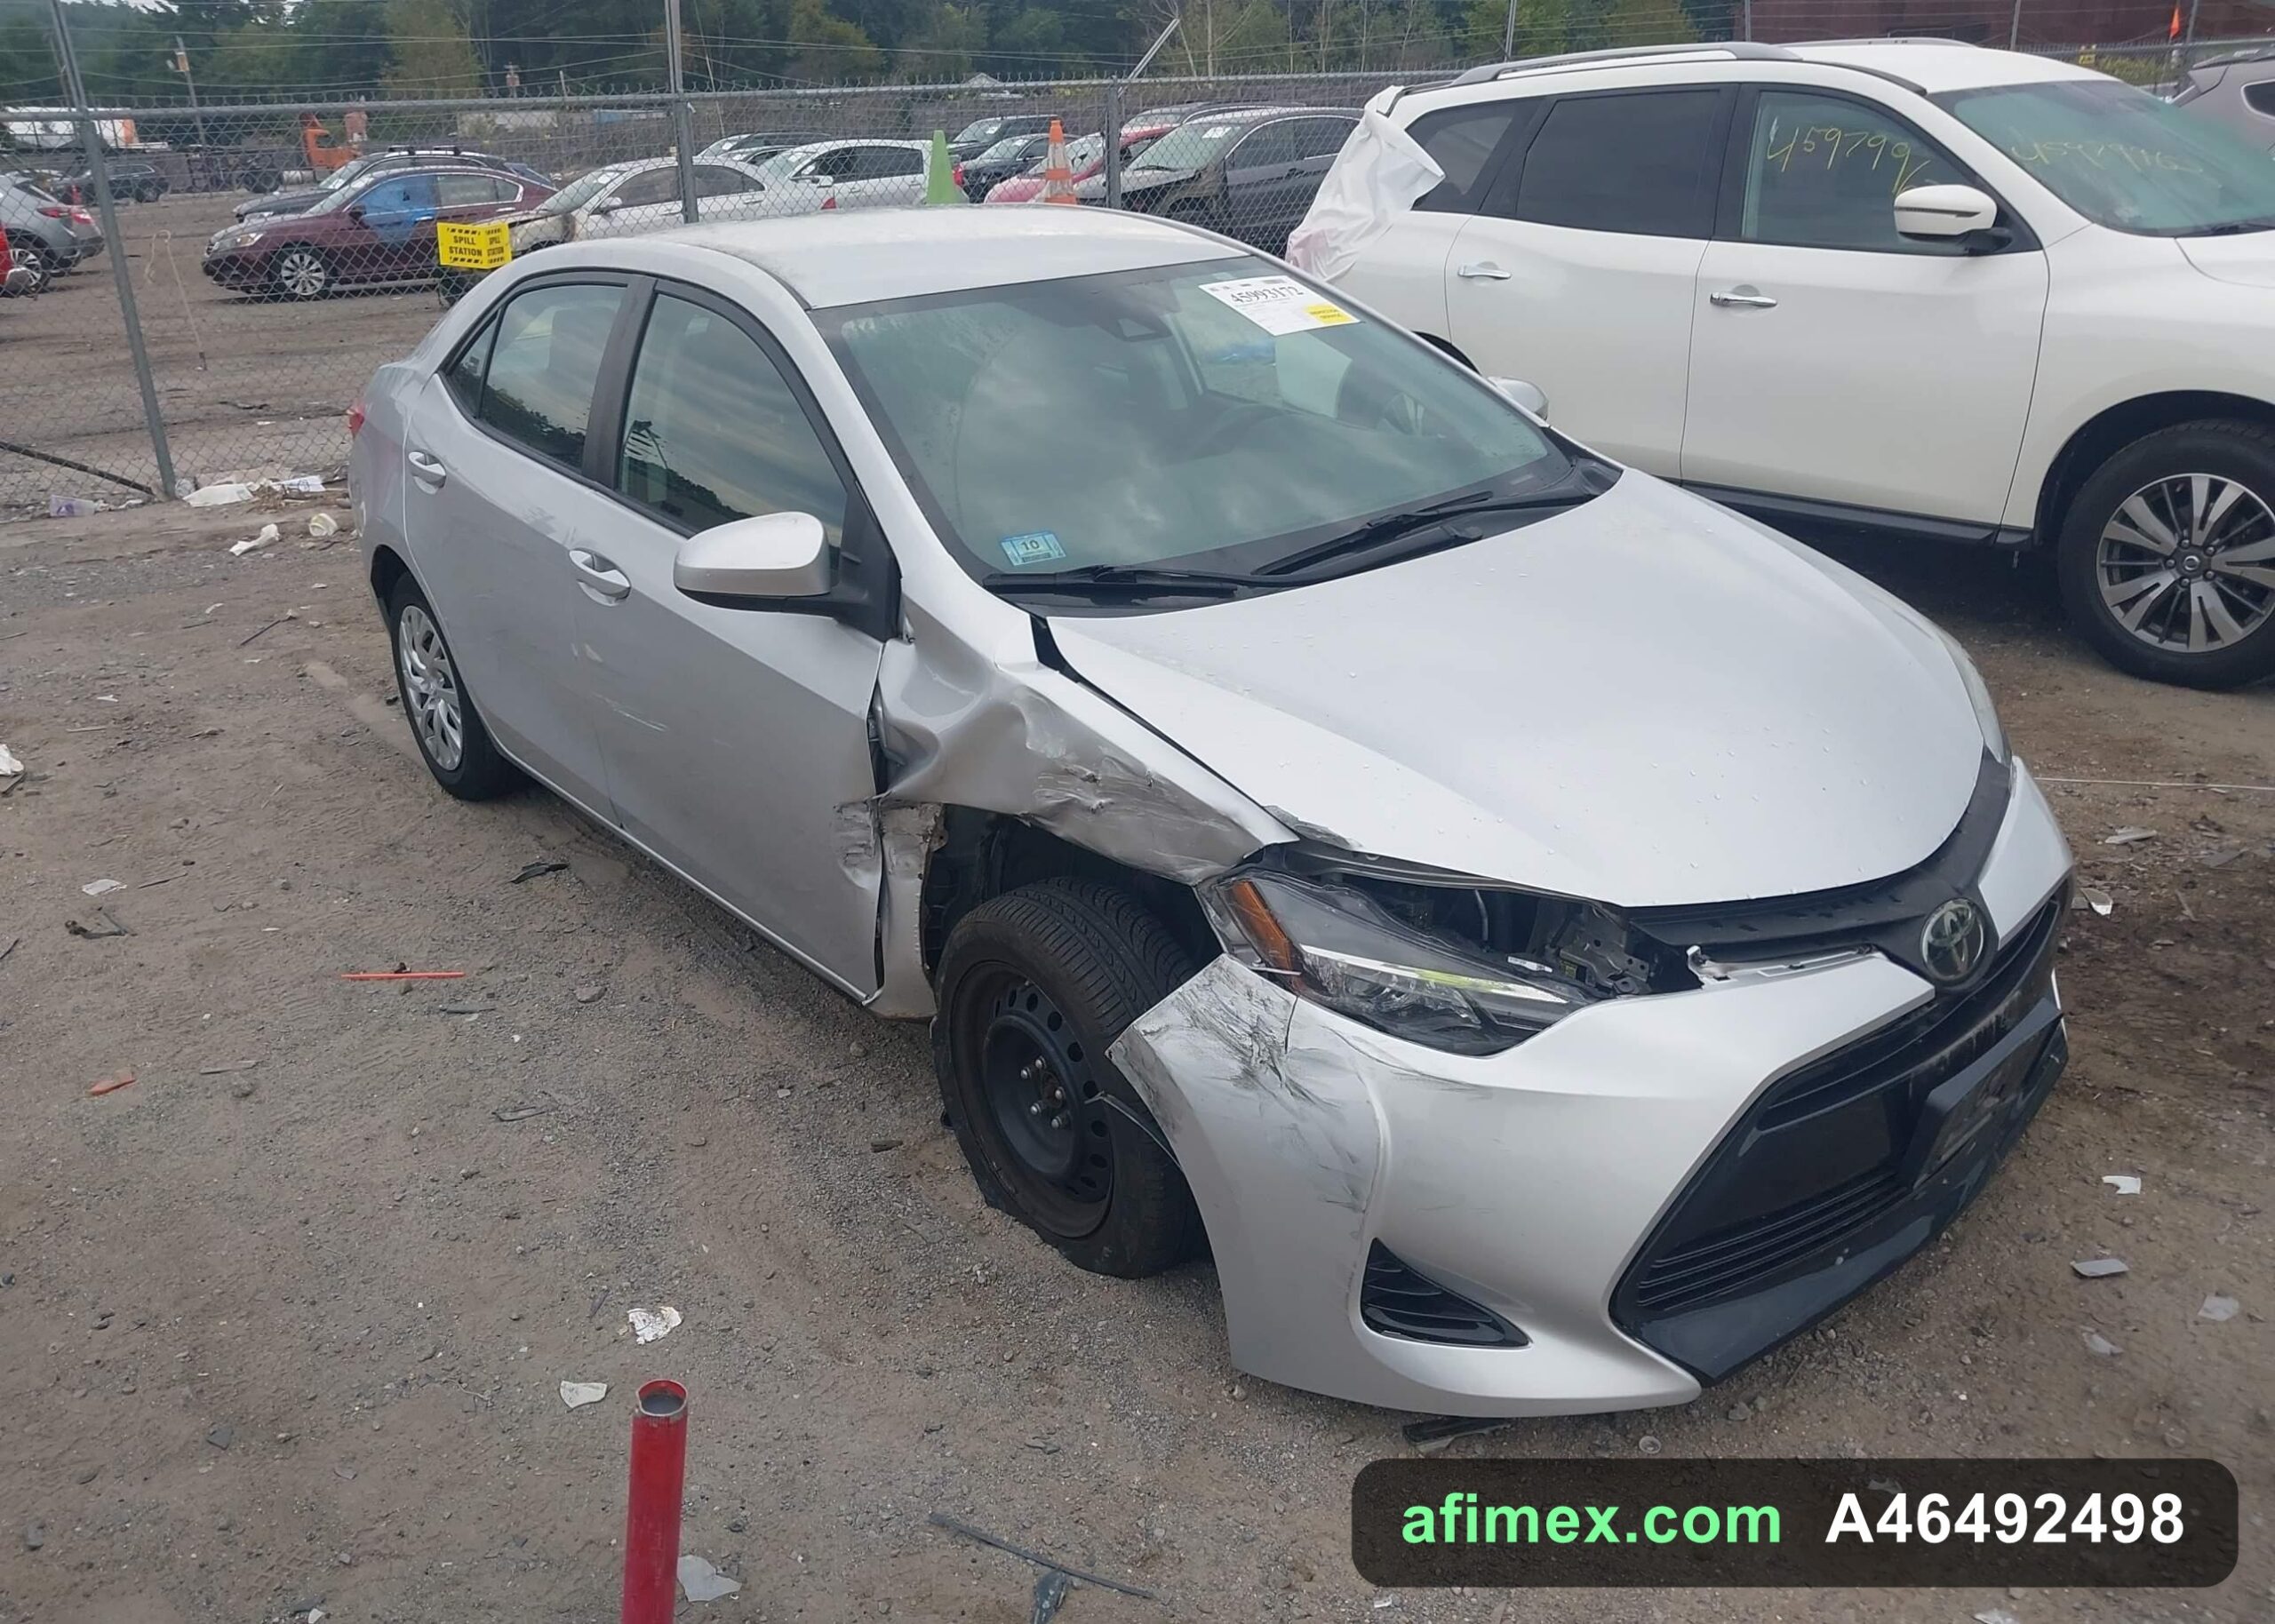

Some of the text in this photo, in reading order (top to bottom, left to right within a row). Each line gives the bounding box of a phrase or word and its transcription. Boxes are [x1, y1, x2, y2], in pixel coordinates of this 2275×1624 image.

[453, 235, 476, 245] SPILL
[489, 236, 501, 245] SPILL
[449, 246, 483, 257] STATION
[1231, 286, 1304, 303] 45993172
[1021, 539, 1040, 551] 10
